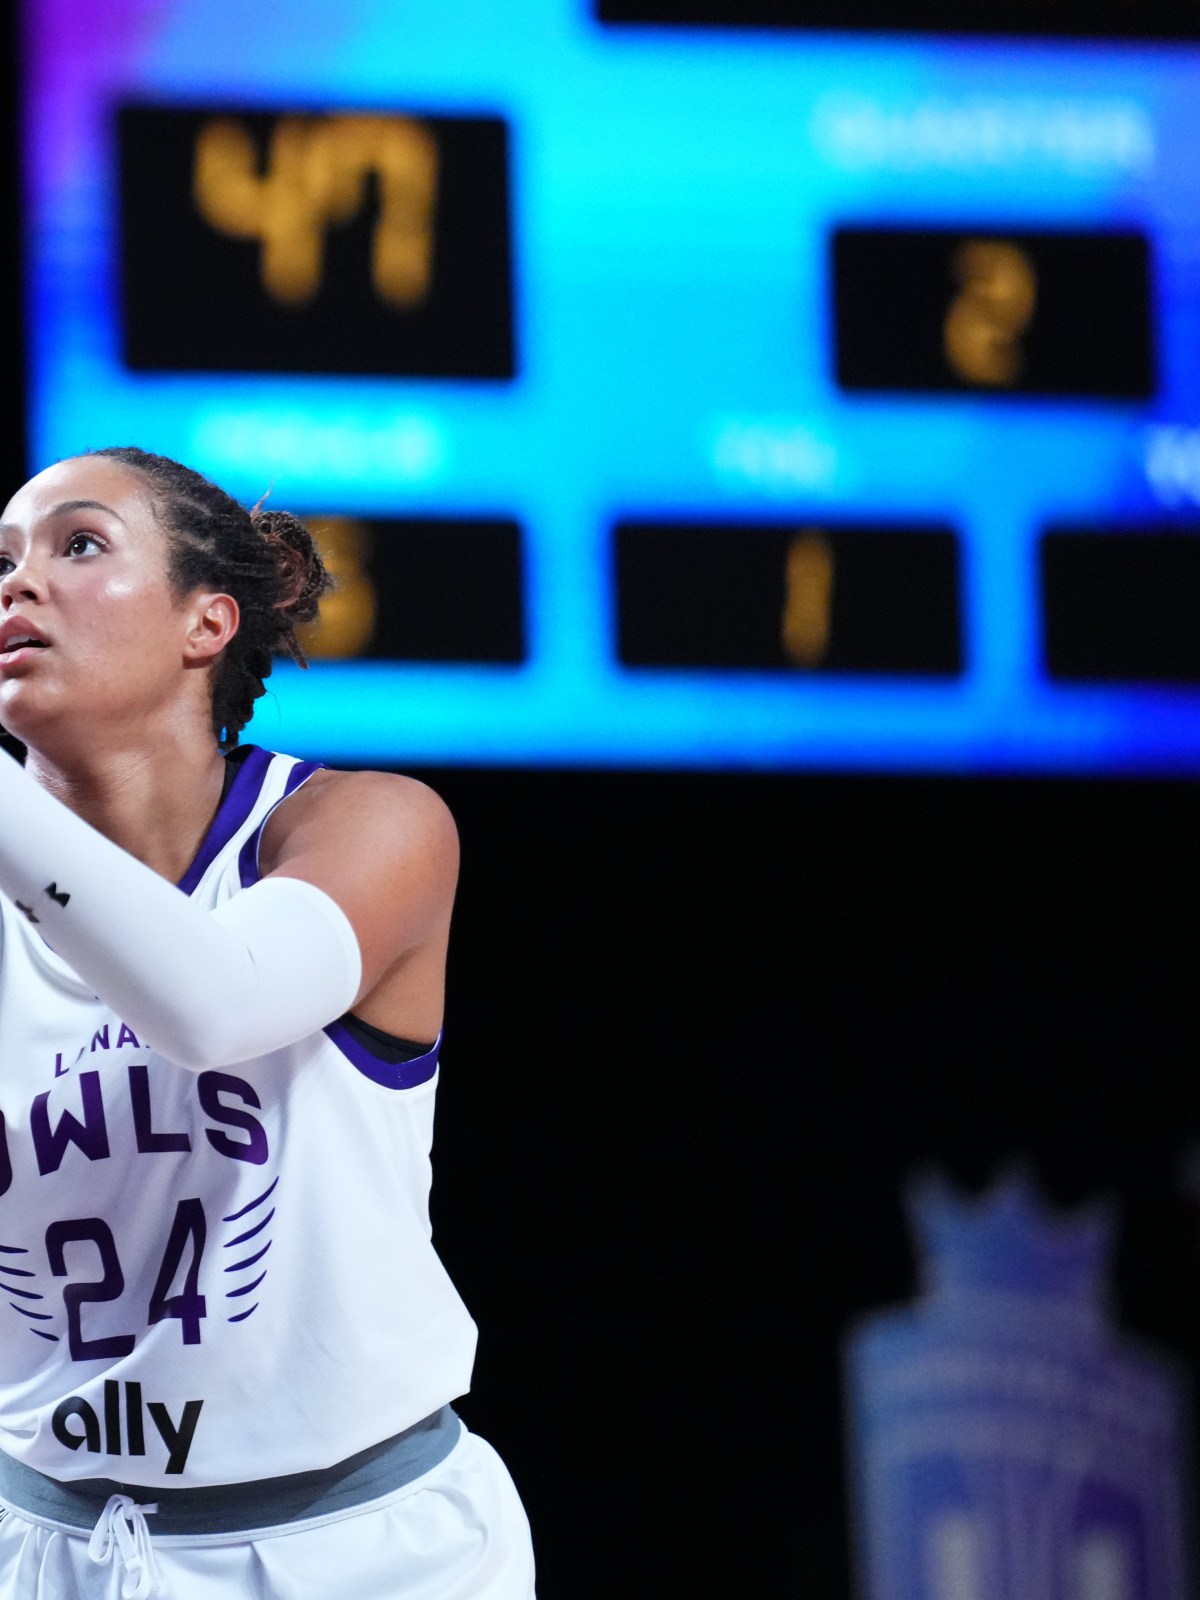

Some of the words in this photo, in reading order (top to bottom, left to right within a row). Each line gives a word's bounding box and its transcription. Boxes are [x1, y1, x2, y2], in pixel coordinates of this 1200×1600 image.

[195, 114, 437, 307] 47
[55, 1022, 150, 1078] LNA
[45, 1198, 207, 1361] 24
[52, 1379, 204, 1474] ally
